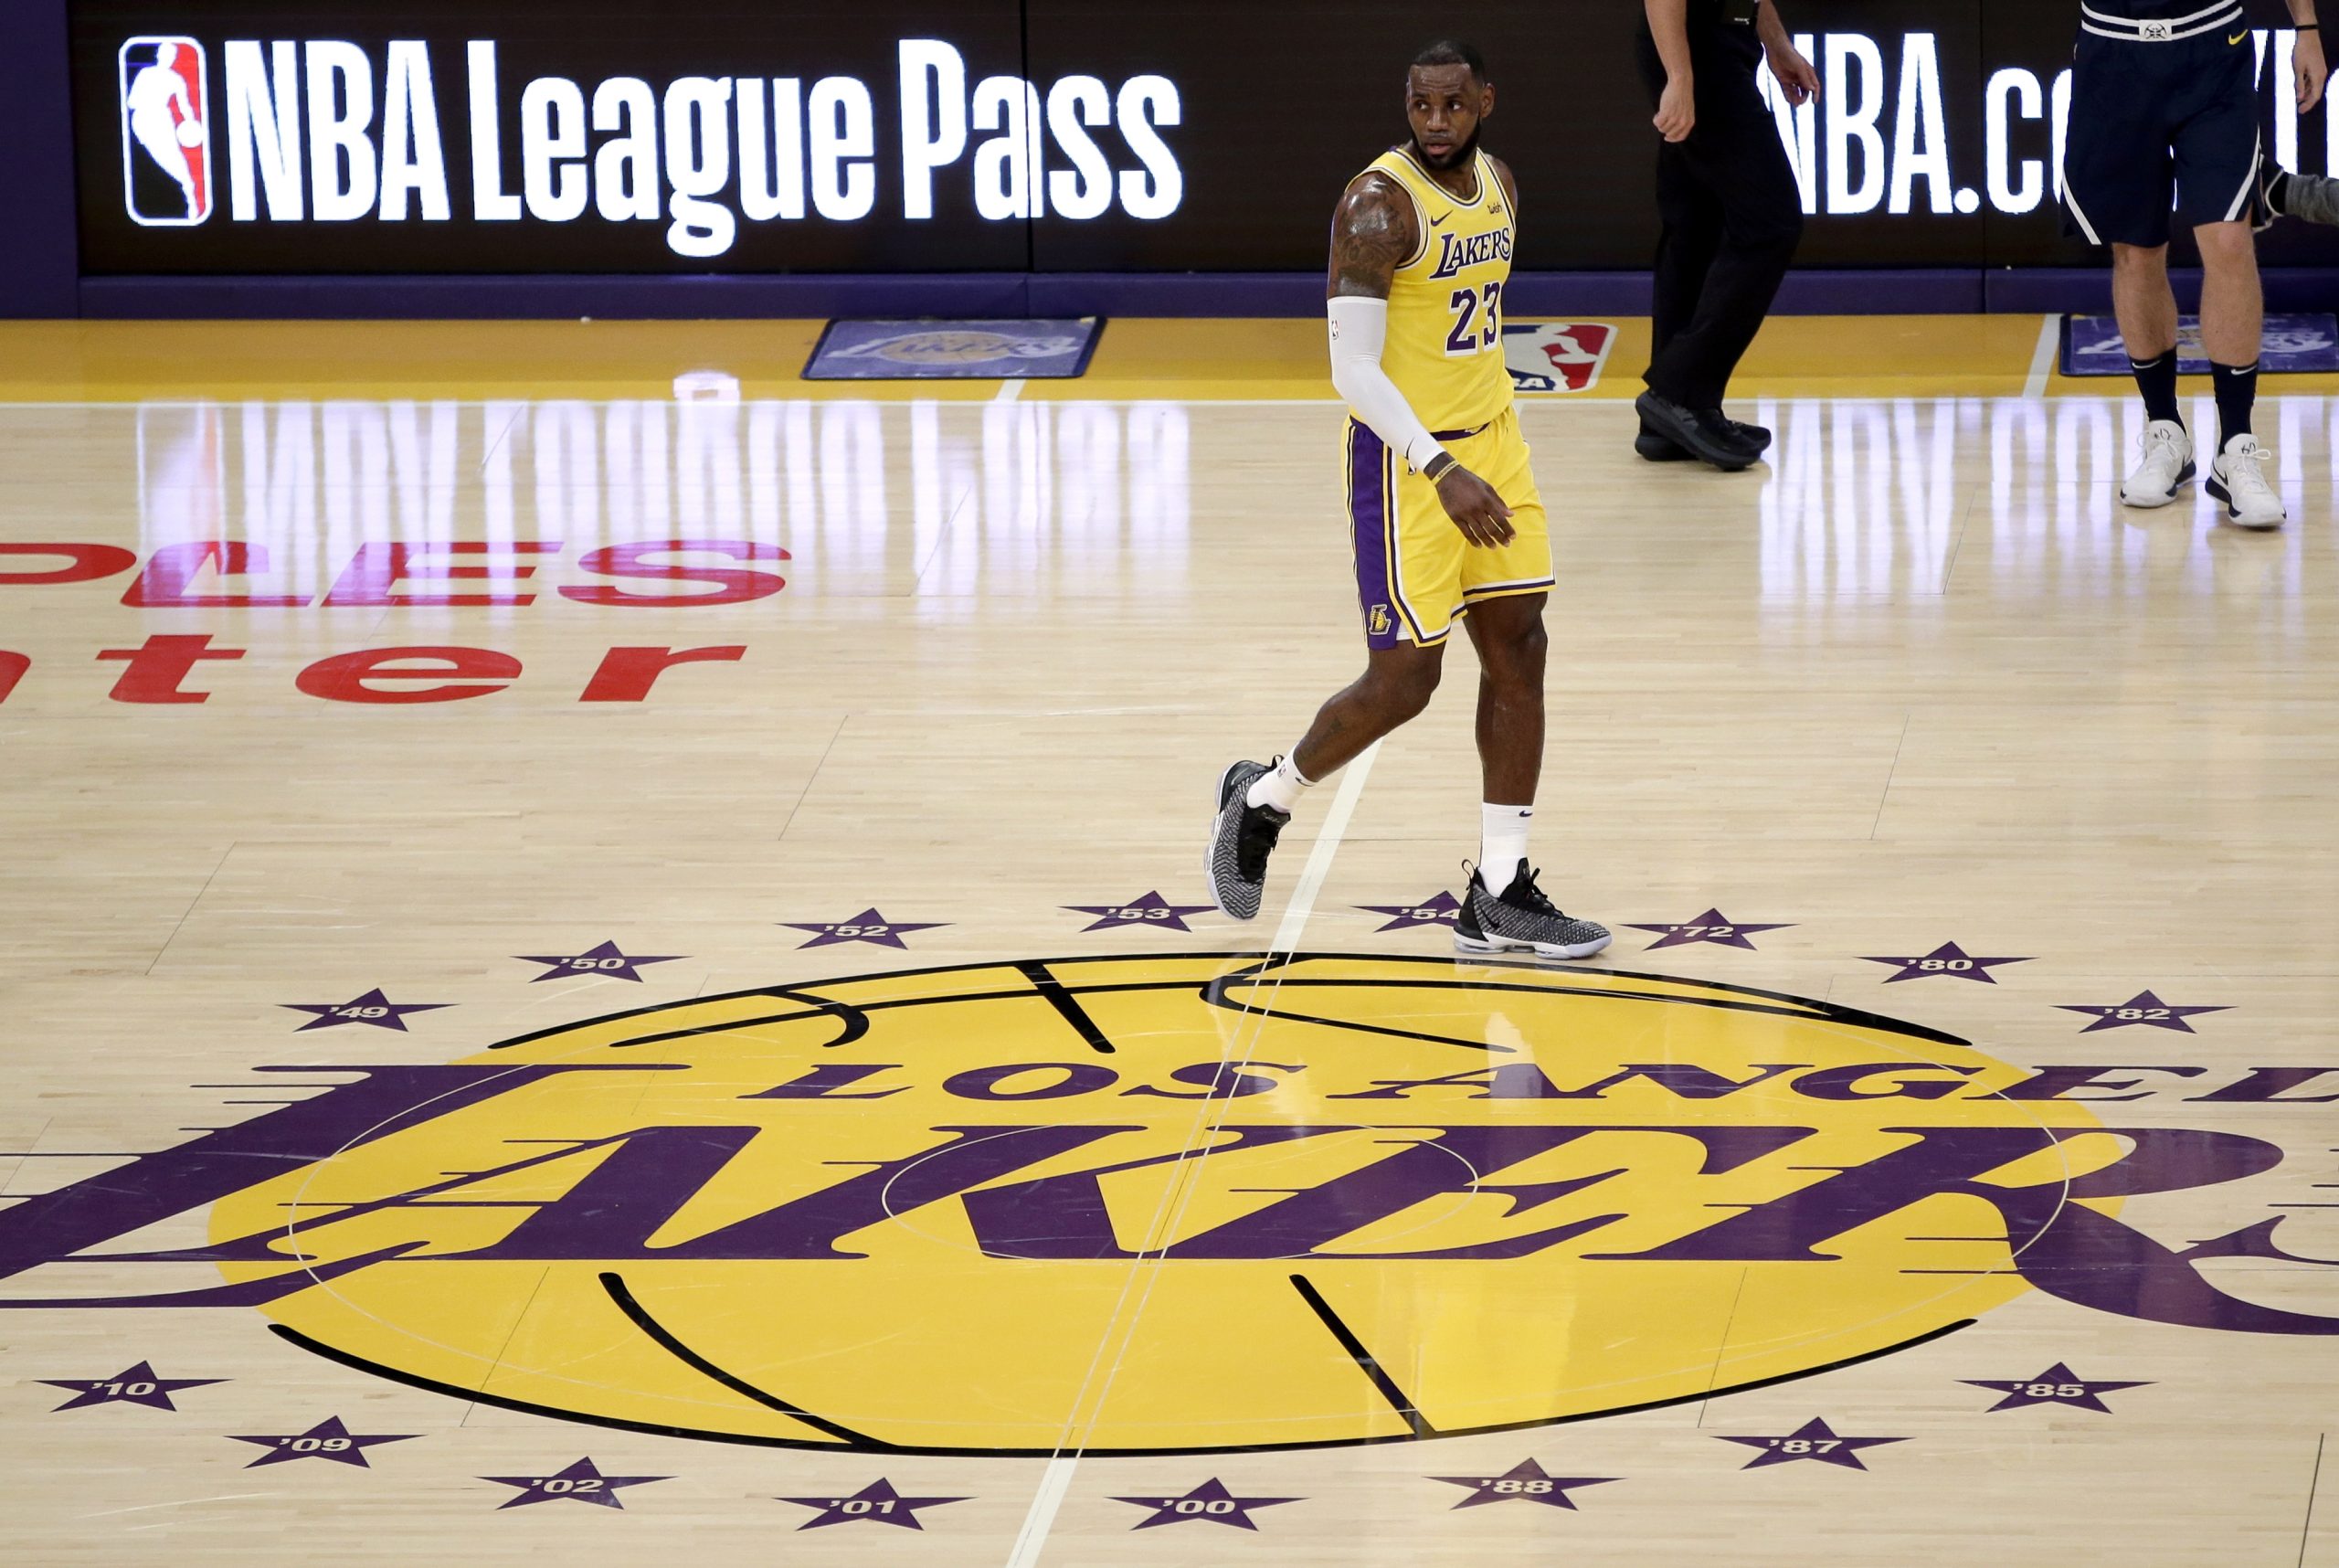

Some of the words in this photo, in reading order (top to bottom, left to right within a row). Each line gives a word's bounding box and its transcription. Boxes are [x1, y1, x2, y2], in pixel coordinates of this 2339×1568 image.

[225, 40, 451, 221] NBA
[467, 40, 875, 258] League
[898, 39, 1182, 220] Pass
[1428, 227, 1511, 280] LAKERS
[1445, 282, 1501, 356] 23
[0, 634, 747, 705] ter
[1107, 907, 1170, 919] '53
[1401, 908, 1460, 919] '54
[823, 925, 889, 937] '52
[1669, 926, 1734, 938] '72
[559, 958, 626, 969] '50
[1908, 959, 1974, 971] '80
[329, 1006, 389, 1019] '49
[2104, 1008, 2171, 1020] '82
[736, 1062, 1308, 1101] LOS
[91, 1382, 156, 1395] '10
[2013, 1383, 2085, 1397] '85
[279, 1437, 353, 1452] '09
[1769, 1439, 1843, 1453] '87
[531, 1478, 604, 1492] '02
[1480, 1479, 1553, 1494] '88
[829, 1499, 896, 1513] '01
[1163, 1499, 1236, 1514] '00
